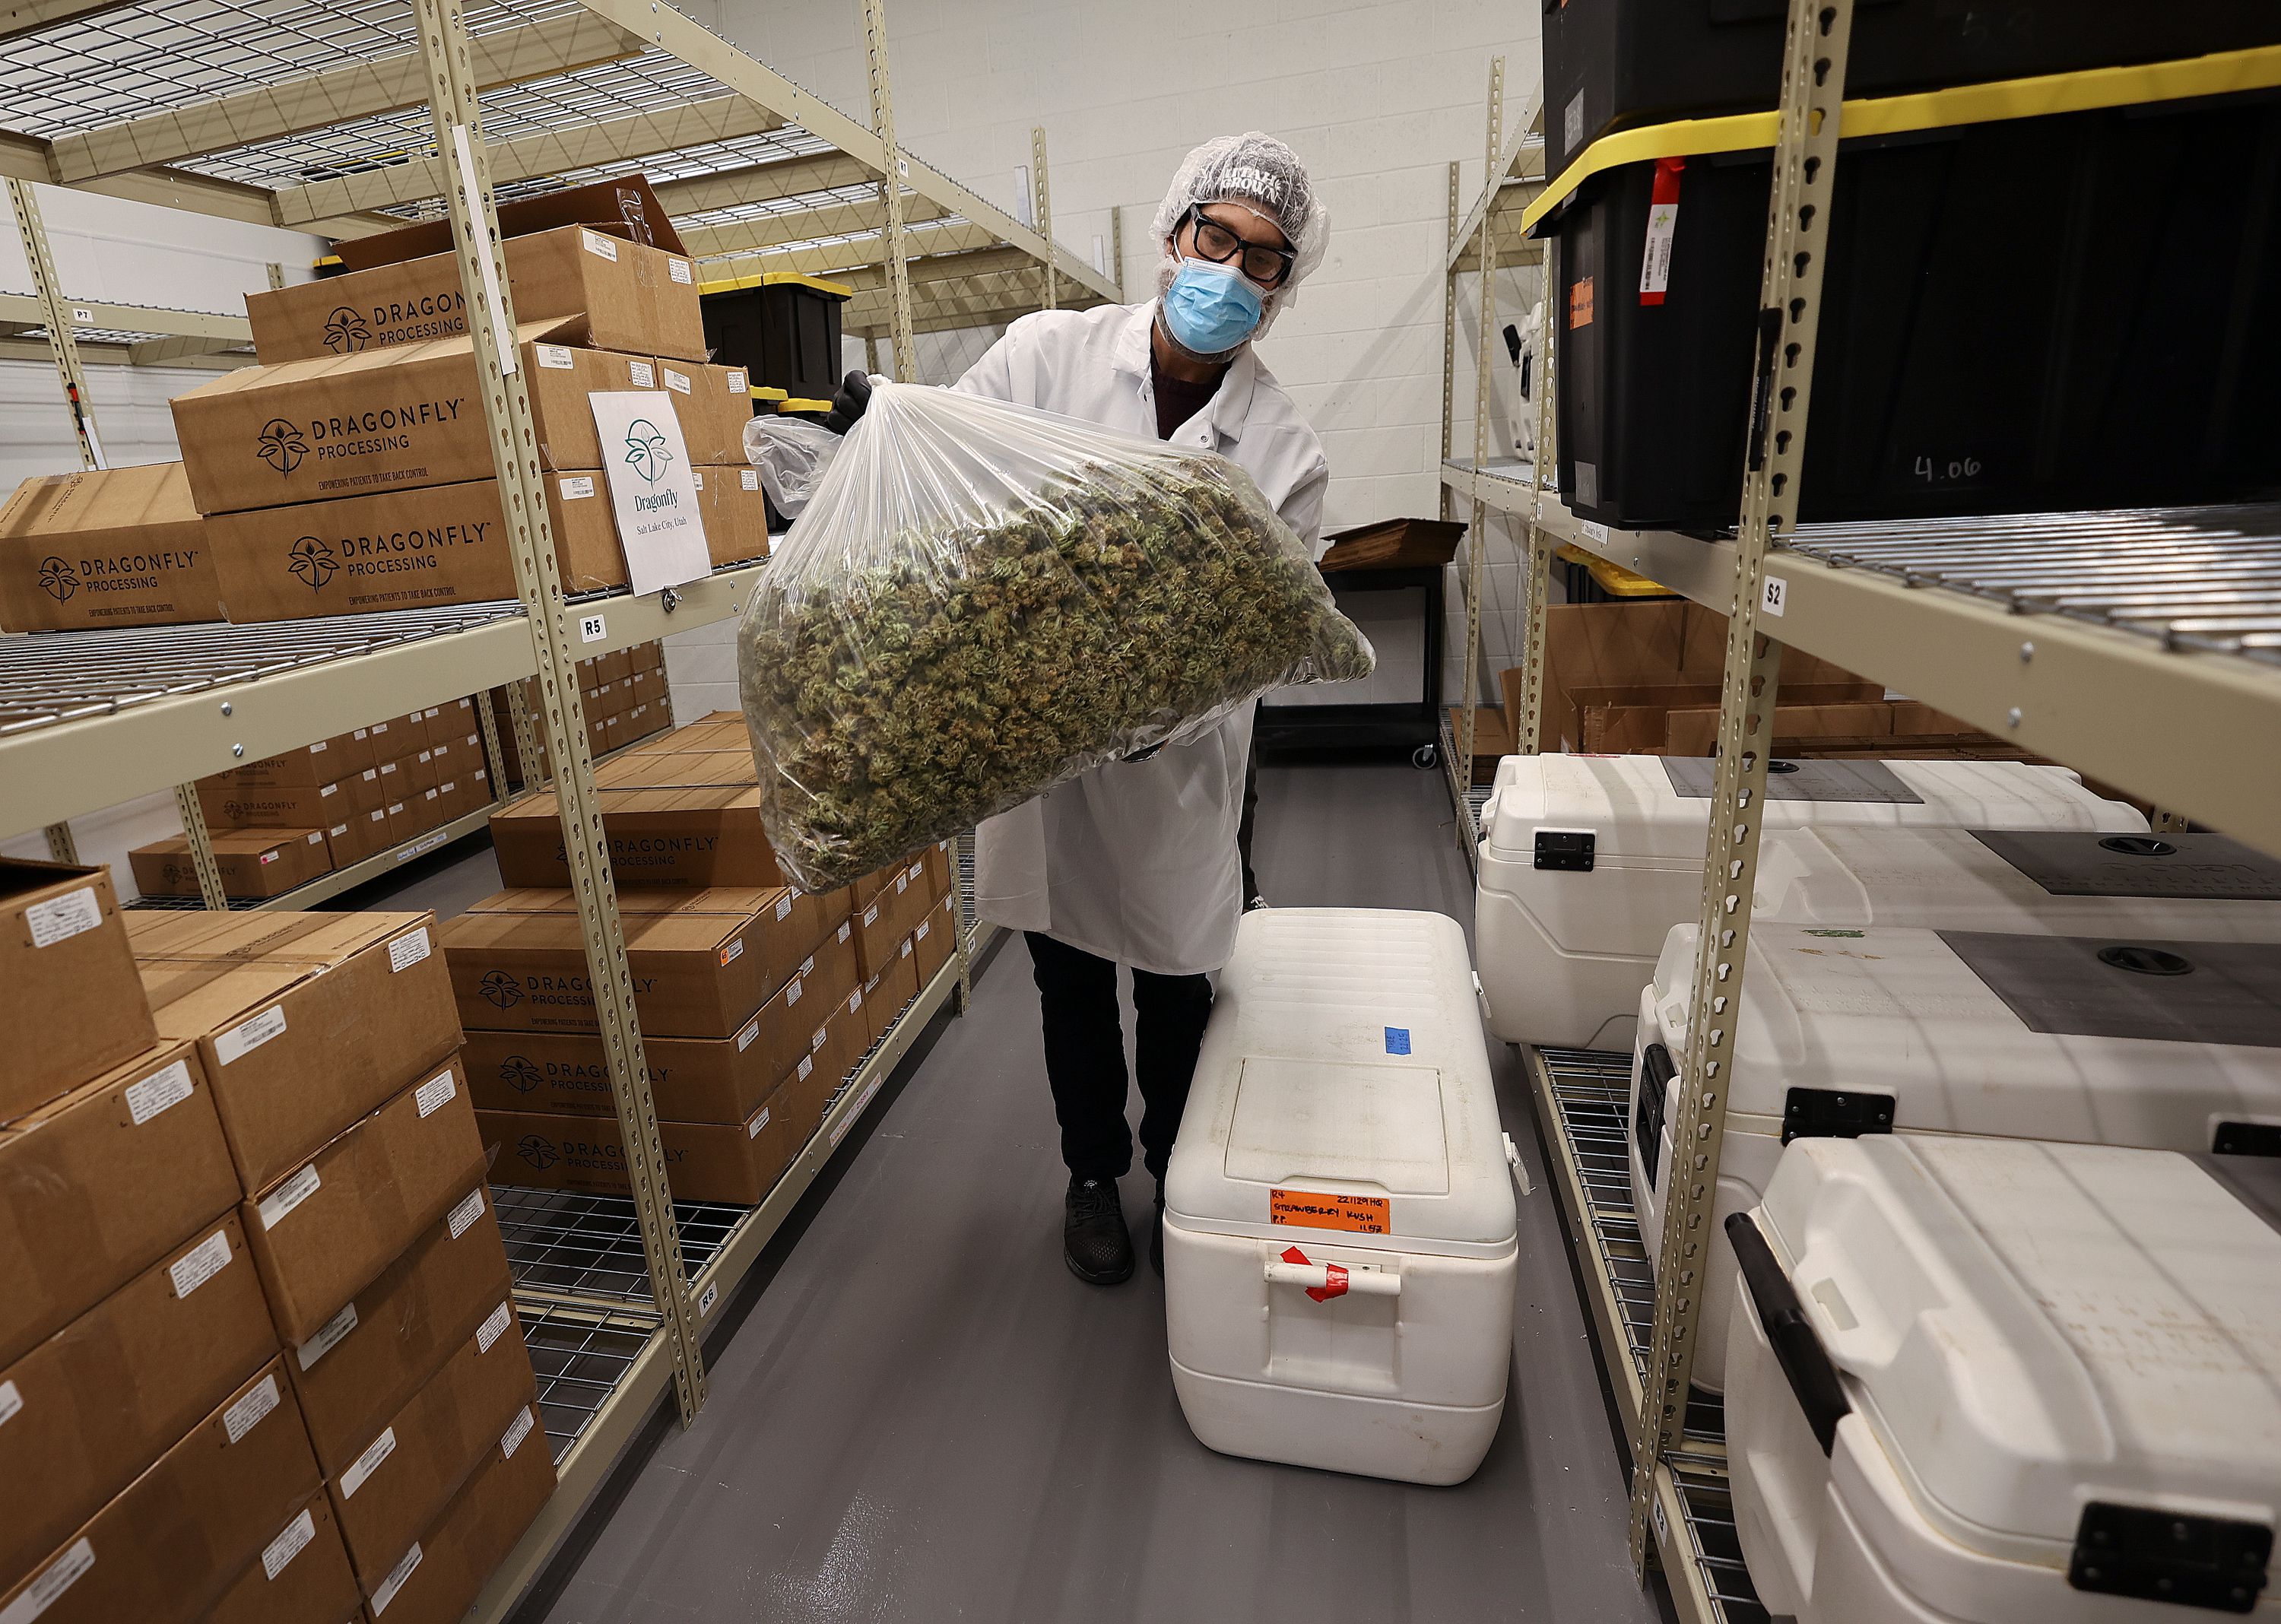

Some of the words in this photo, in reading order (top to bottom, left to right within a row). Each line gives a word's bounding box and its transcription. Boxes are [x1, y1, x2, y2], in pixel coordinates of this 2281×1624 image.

[77, 310, 87, 319] P7
[373, 290, 466, 326] DRAGON
[379, 316, 464, 345] PROCESSING
[318, 434, 410, 460] PROCESSING
[318, 478, 350, 490] EMPOWERING
[349, 474, 372, 487] PATIENTS
[373, 474, 379, 484] TO
[379, 471, 392, 482] TAKE
[392, 470, 406, 481] BACK
[405, 467, 429, 479] CONTROL
[1915, 455, 1982, 482] 4.06
[634, 488, 678, 512] Dragonfly
[636, 525, 648, 535] Salt
[648, 522, 661, 533] Lake
[661, 519, 674, 531] City,
[674, 516, 687, 527] Utah
[347, 554, 437, 576] PROCESSING
[87, 576, 158, 592] PROCESSING
[1767, 582, 1781, 605] S2
[348, 595, 379, 606] EMPOWERING
[379, 592, 401, 603] PATIENTS
[401, 591, 408, 601] TO
[408, 589, 420, 599] TAKE
[420, 588, 434, 599] BACK
[433, 586, 456, 598] CONTROL
[585, 619, 601, 636] R5
[611, 855, 675, 867] ROCESSING
[527, 976, 653, 993] DRAGLY
[532, 994, 595, 1006] PROCESSI
[546, 1062, 668, 1082] DRAGLY
[551, 1080, 612, 1093] PROCESSI
[563, 1142, 684, 1162] DRAGLY
[568, 1157, 629, 1171] PROCESSI
[1271, 1191, 1285, 1200] R4
[1274, 1203, 1340, 1218] STRAWBERRY
[1347, 1210, 1373, 1223] KUSH
[702, 1288, 714, 1309] R6
